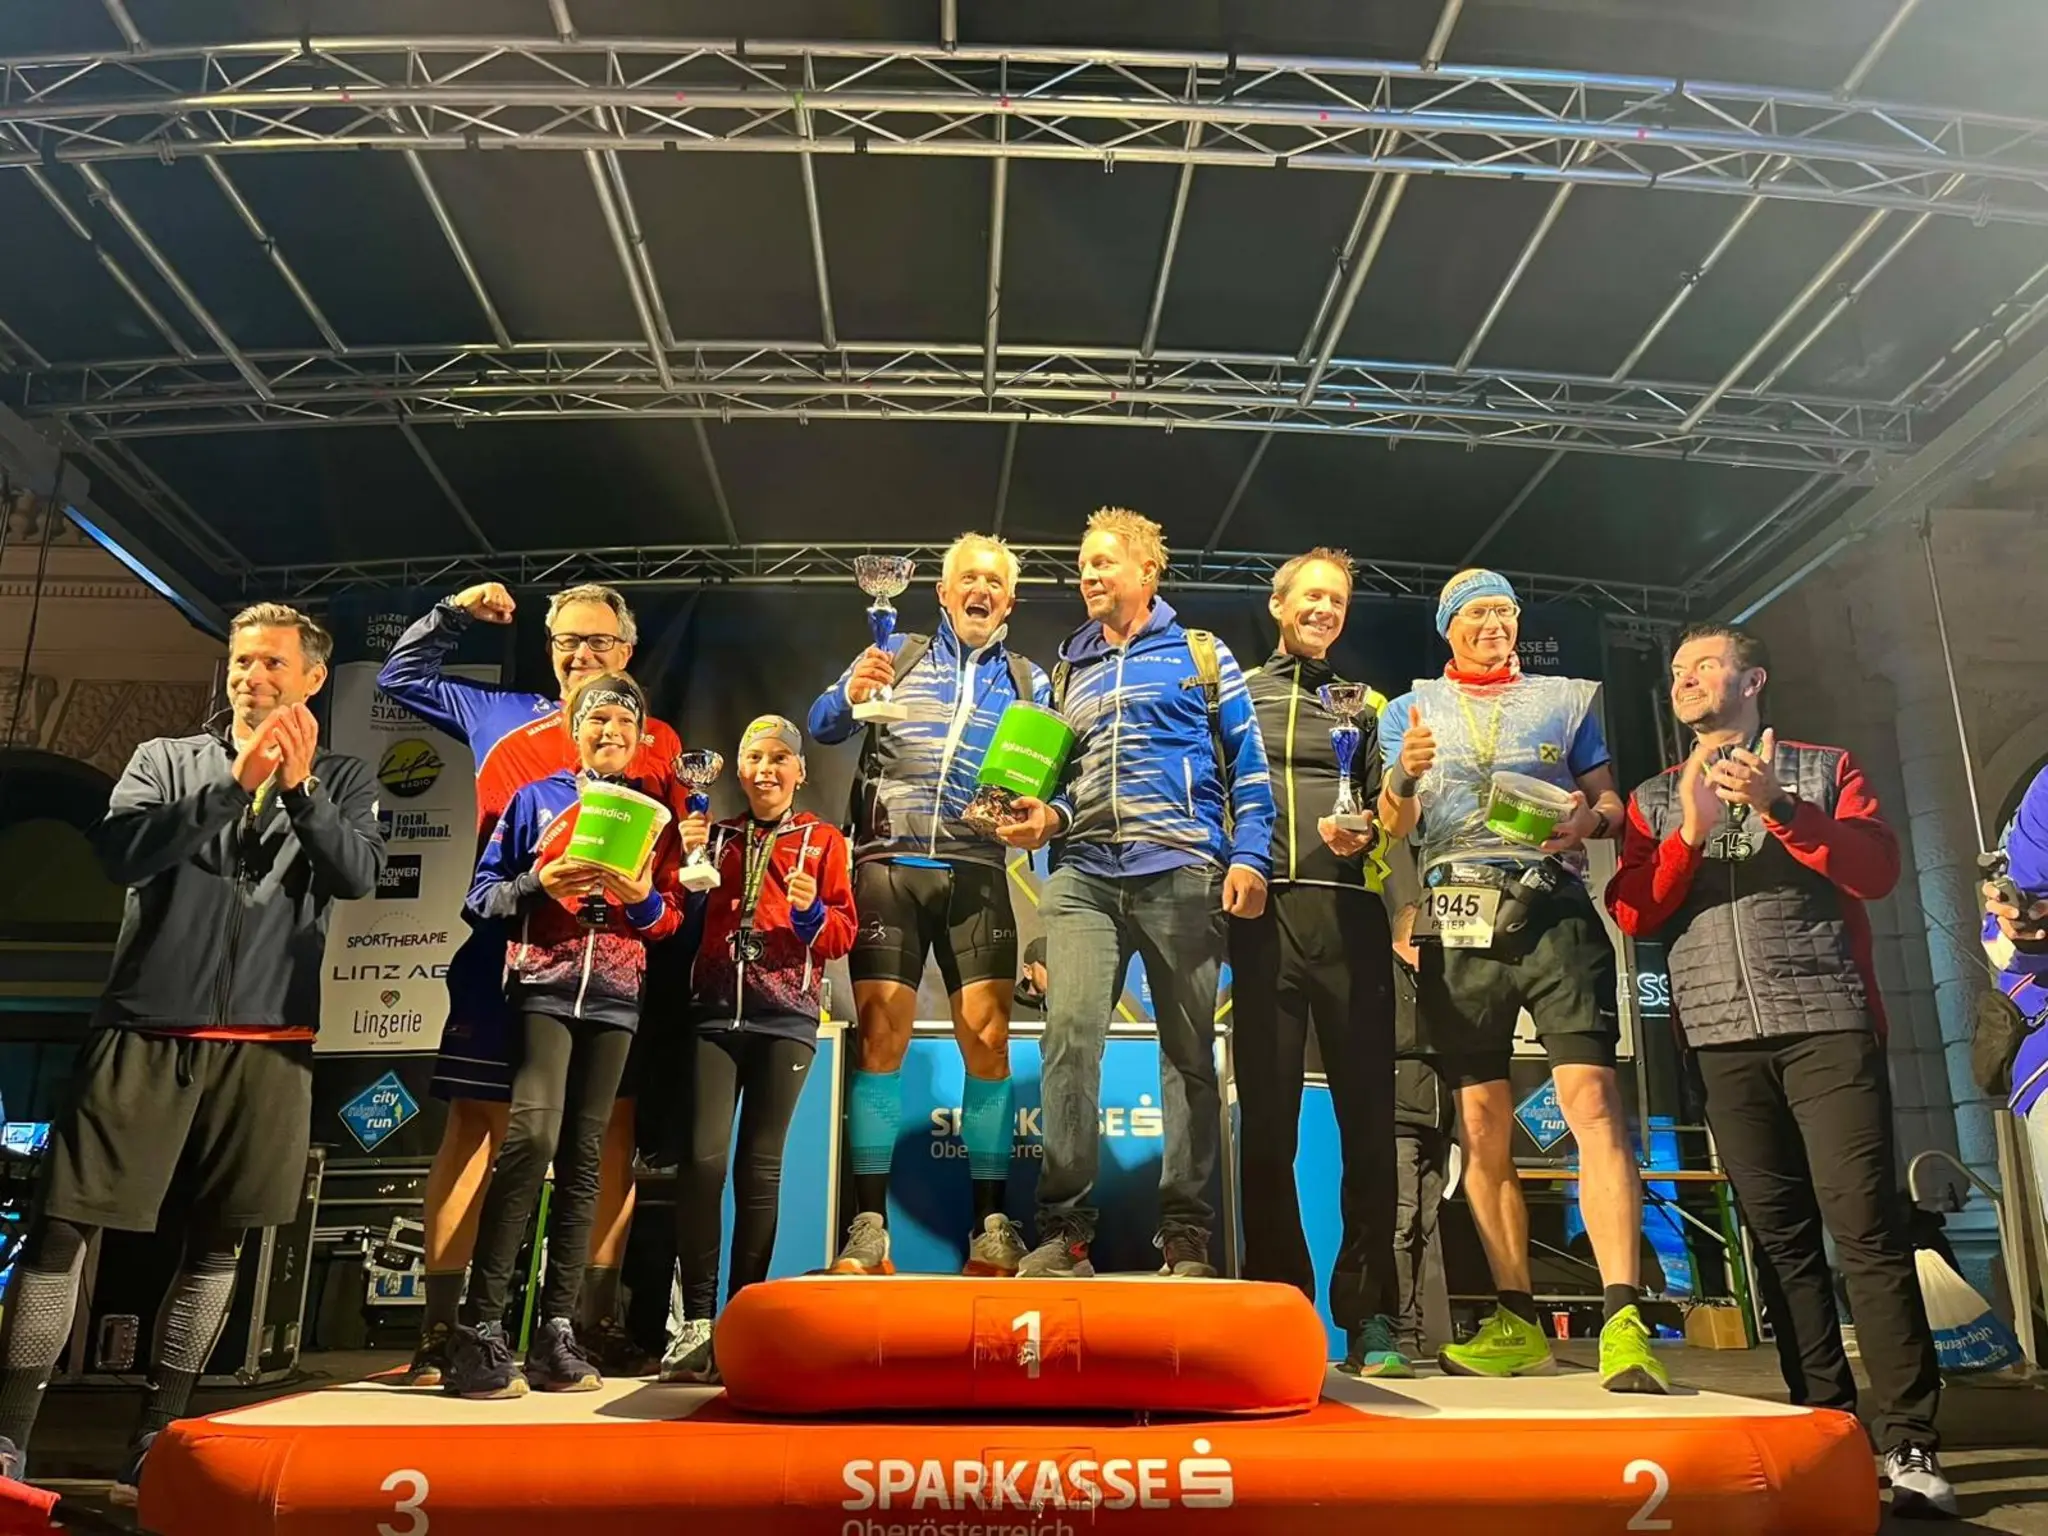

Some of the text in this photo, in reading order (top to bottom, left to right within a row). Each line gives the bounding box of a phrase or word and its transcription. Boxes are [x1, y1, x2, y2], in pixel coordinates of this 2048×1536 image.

[401, 779, 430, 788] RADIO
[397, 812, 429, 826] total.
[395, 824, 452, 839] regional.
[1712, 832, 1753, 861] 15
[1424, 893, 1480, 917] 1945
[1431, 919, 1465, 930] PETER
[372, 1090, 400, 1106] city
[366, 1117, 393, 1129] run
[1541, 1119, 1565, 1130] run
[1012, 1310, 1041, 1379] 1
[842, 1458, 1169, 1511] SPARKASSE
[377, 1468, 429, 1536] 3
[1623, 1458, 1672, 1530] 2
